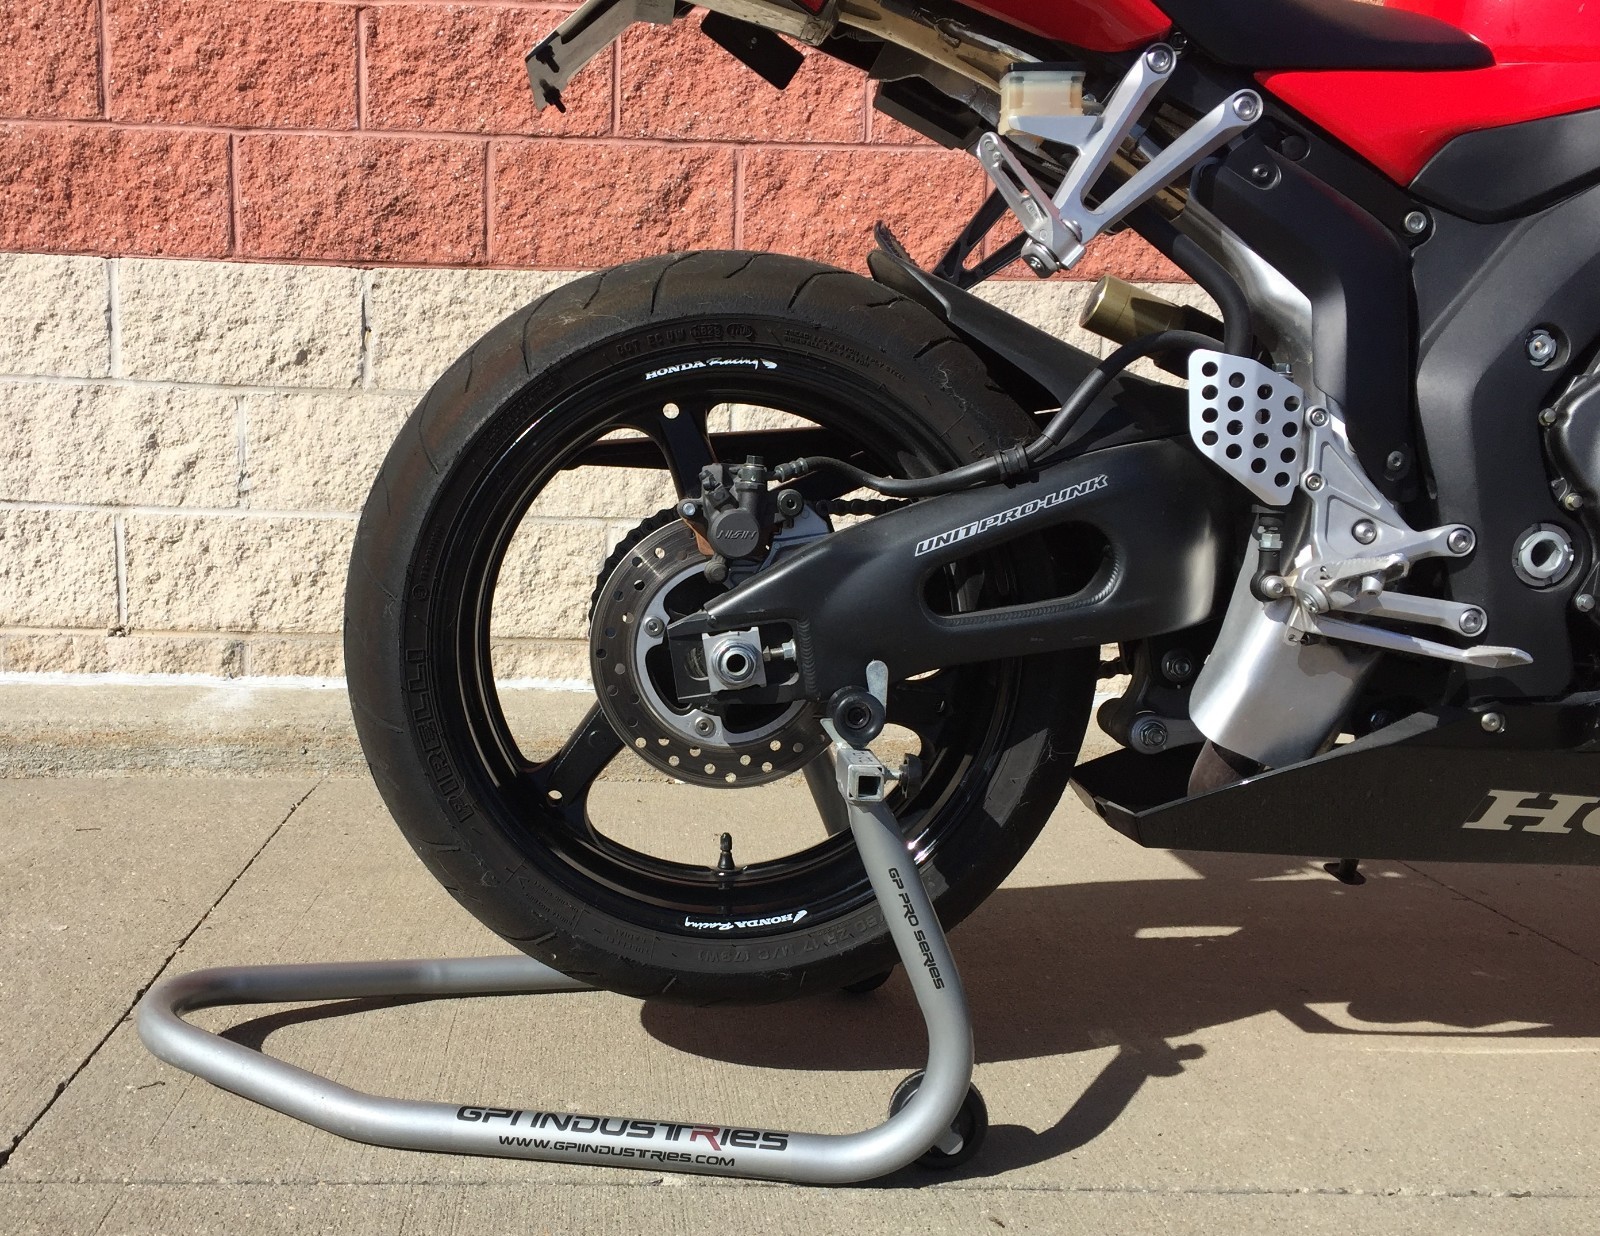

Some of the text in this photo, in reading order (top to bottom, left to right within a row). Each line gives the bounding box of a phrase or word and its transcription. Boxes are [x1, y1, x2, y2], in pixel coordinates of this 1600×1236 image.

[645, 357, 759, 380] HONDA Racing
[915, 474, 1109, 556] UNIT PRO-LINK
[405, 649, 476, 823] PIRELLI
[1461, 789, 1600, 837] H
[888, 867, 905, 890] GP
[898, 892, 919, 927] PRO
[684, 913, 793, 931] HONDA Racing
[456, 1105, 523, 1125] GPI
